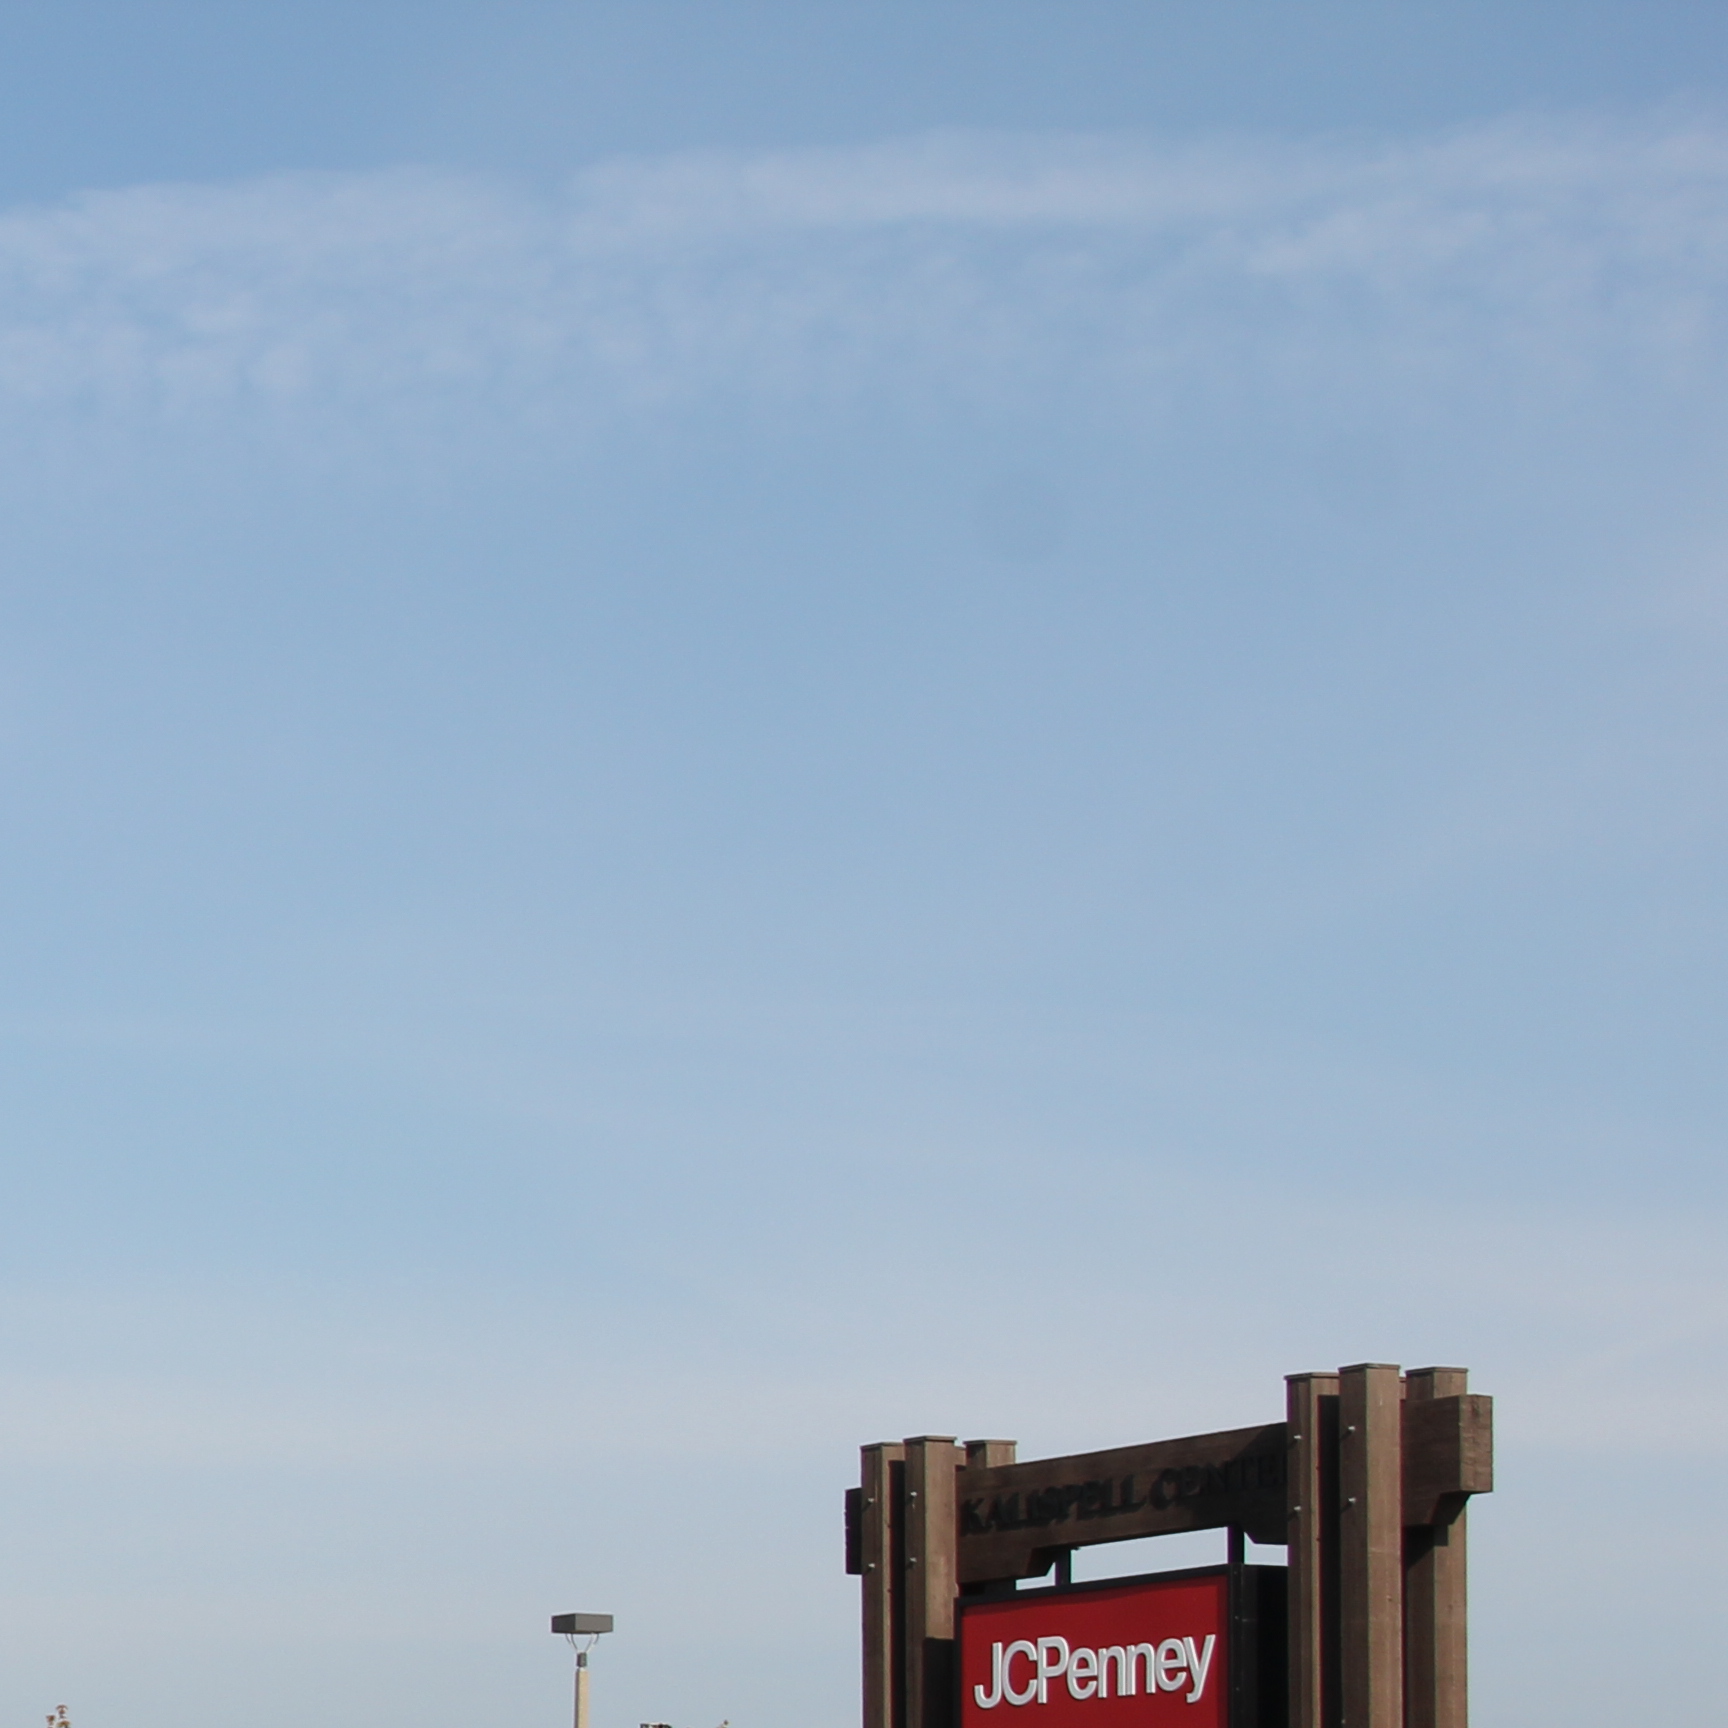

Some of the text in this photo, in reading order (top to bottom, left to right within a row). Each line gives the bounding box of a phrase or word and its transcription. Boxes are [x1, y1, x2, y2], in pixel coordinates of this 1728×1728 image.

[961, 1454, 1288, 1535] KALISPELL CENTE
[974, 1634, 1216, 1709] JCPenney
